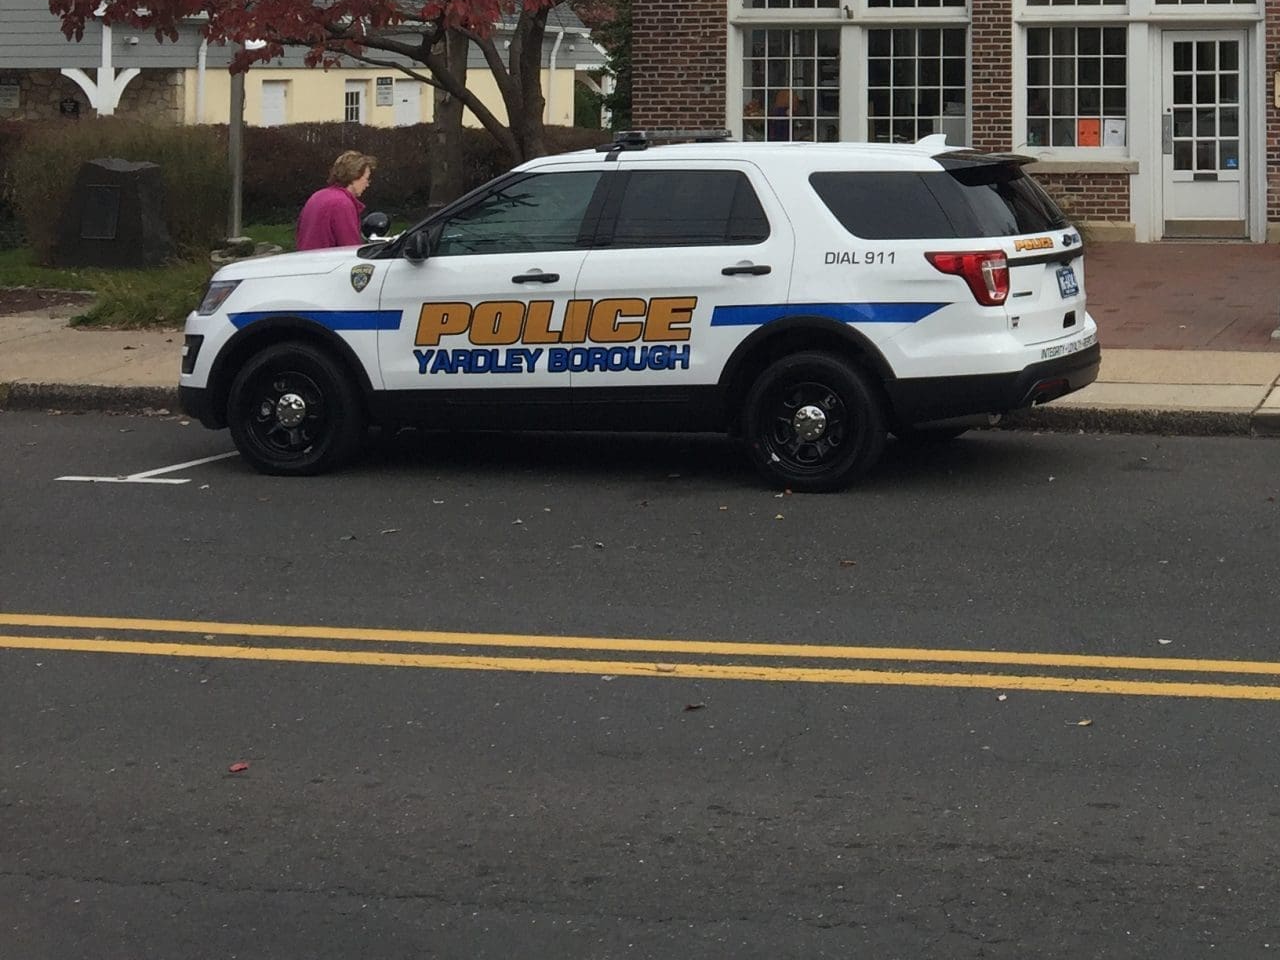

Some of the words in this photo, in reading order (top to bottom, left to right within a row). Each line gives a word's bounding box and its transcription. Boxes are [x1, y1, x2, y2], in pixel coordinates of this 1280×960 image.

[824, 251, 860, 265] DIAL
[864, 251, 896, 265] 911
[414, 296, 698, 346] POLICE
[413, 348, 544, 374] YARDLEY
[547, 345, 691, 373] BOROUGH
